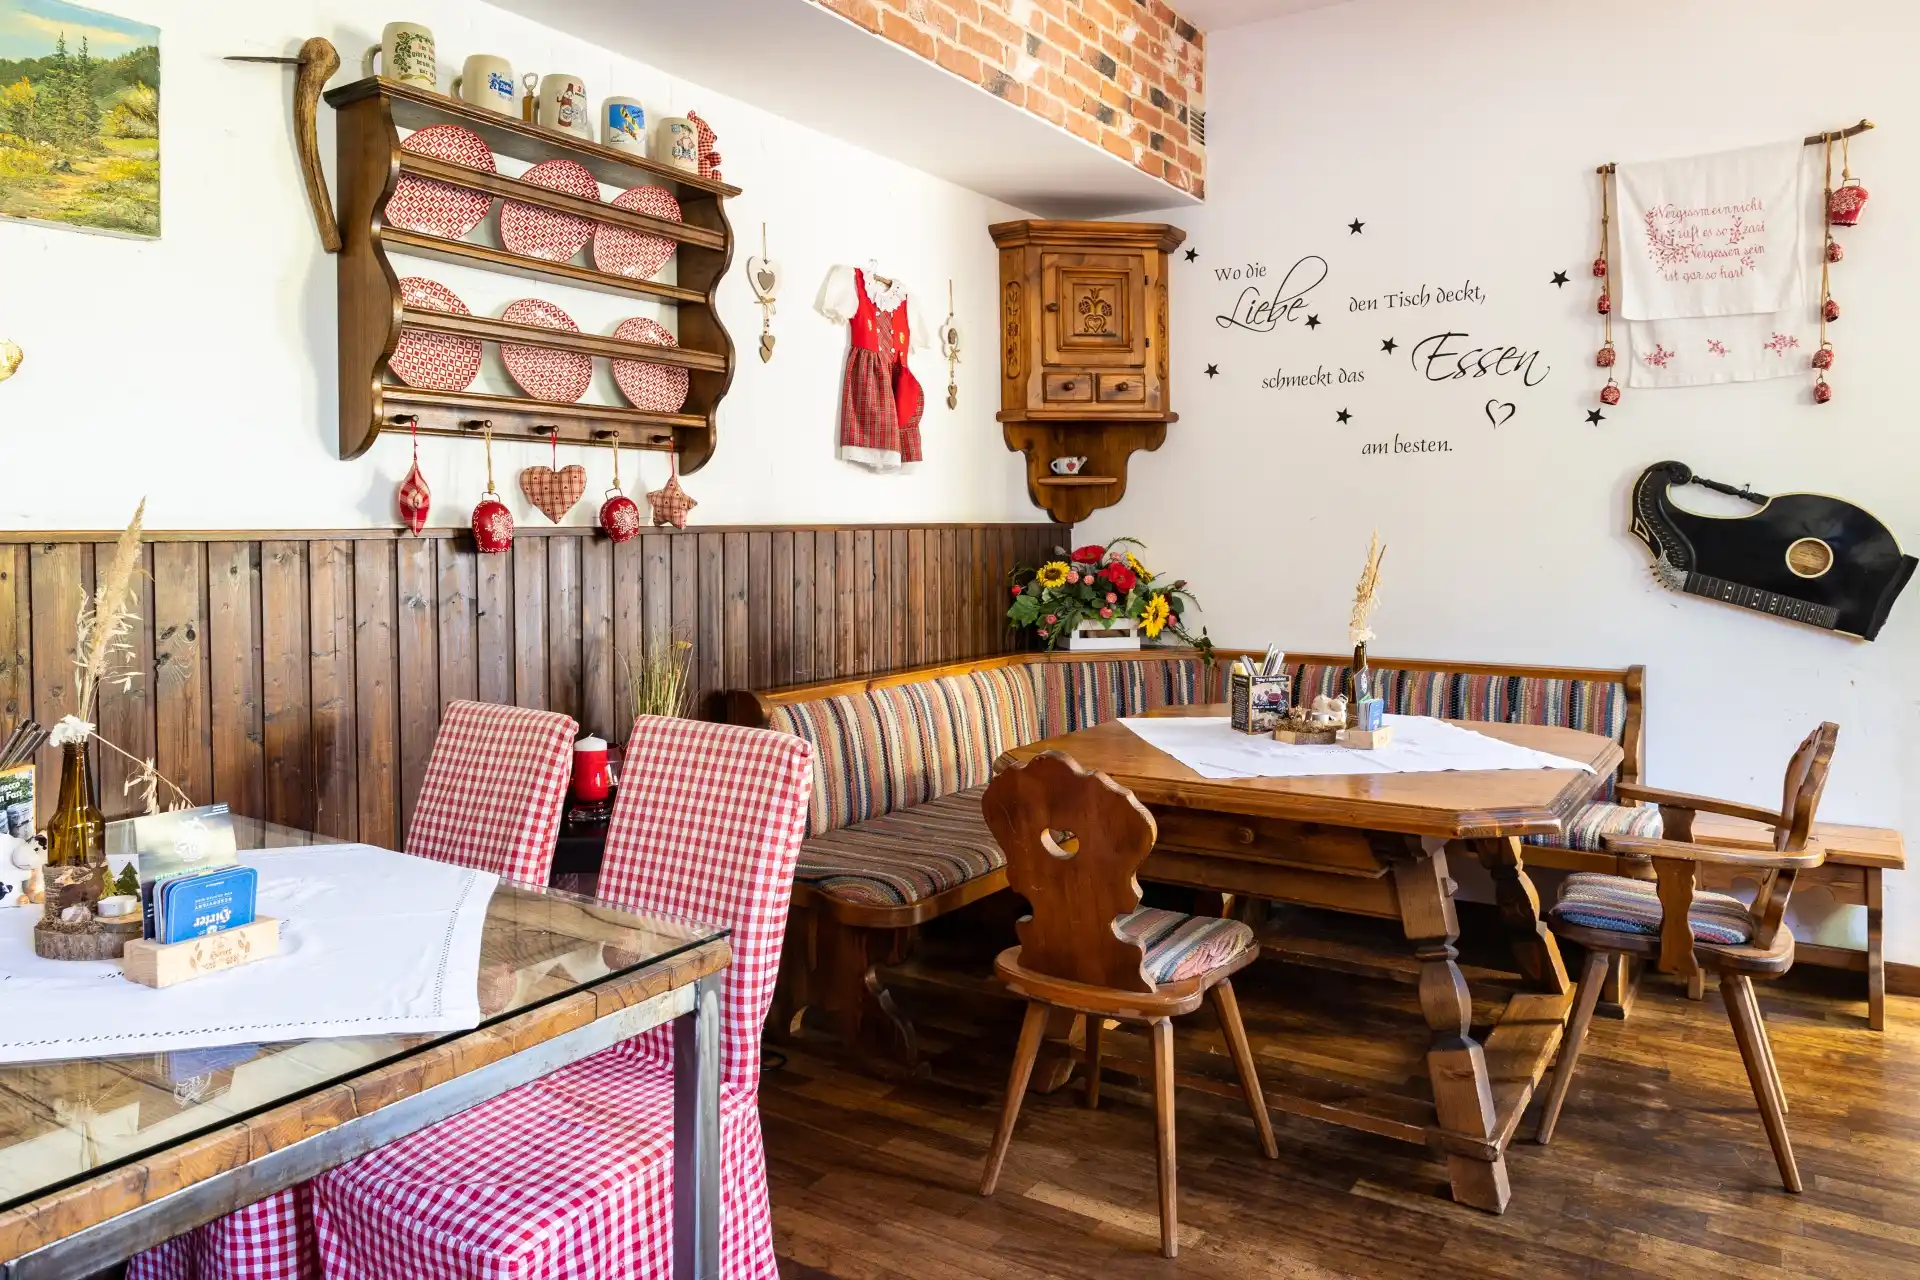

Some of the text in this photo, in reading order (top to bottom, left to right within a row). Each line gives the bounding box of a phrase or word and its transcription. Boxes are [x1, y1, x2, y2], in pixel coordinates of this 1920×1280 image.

[1702, 229, 1713, 238] es
[1716, 228, 1728, 237] so
[1687, 243, 1765, 263] Vergessen sein
[1213, 262, 1267, 282] Wo die
[1664, 270, 1679, 281] ist
[1682, 271, 1702, 283] gar
[1704, 270, 1717, 280] so
[1214, 256, 1329, 333] Liebe
[1348, 279, 1487, 313] den Tisch deckt,
[1411, 331, 1551, 387] Essen
[1261, 364, 1365, 390] schmeckt das
[1361, 432, 1453, 455] am besten.
[193, 906, 232, 928] Hirter
